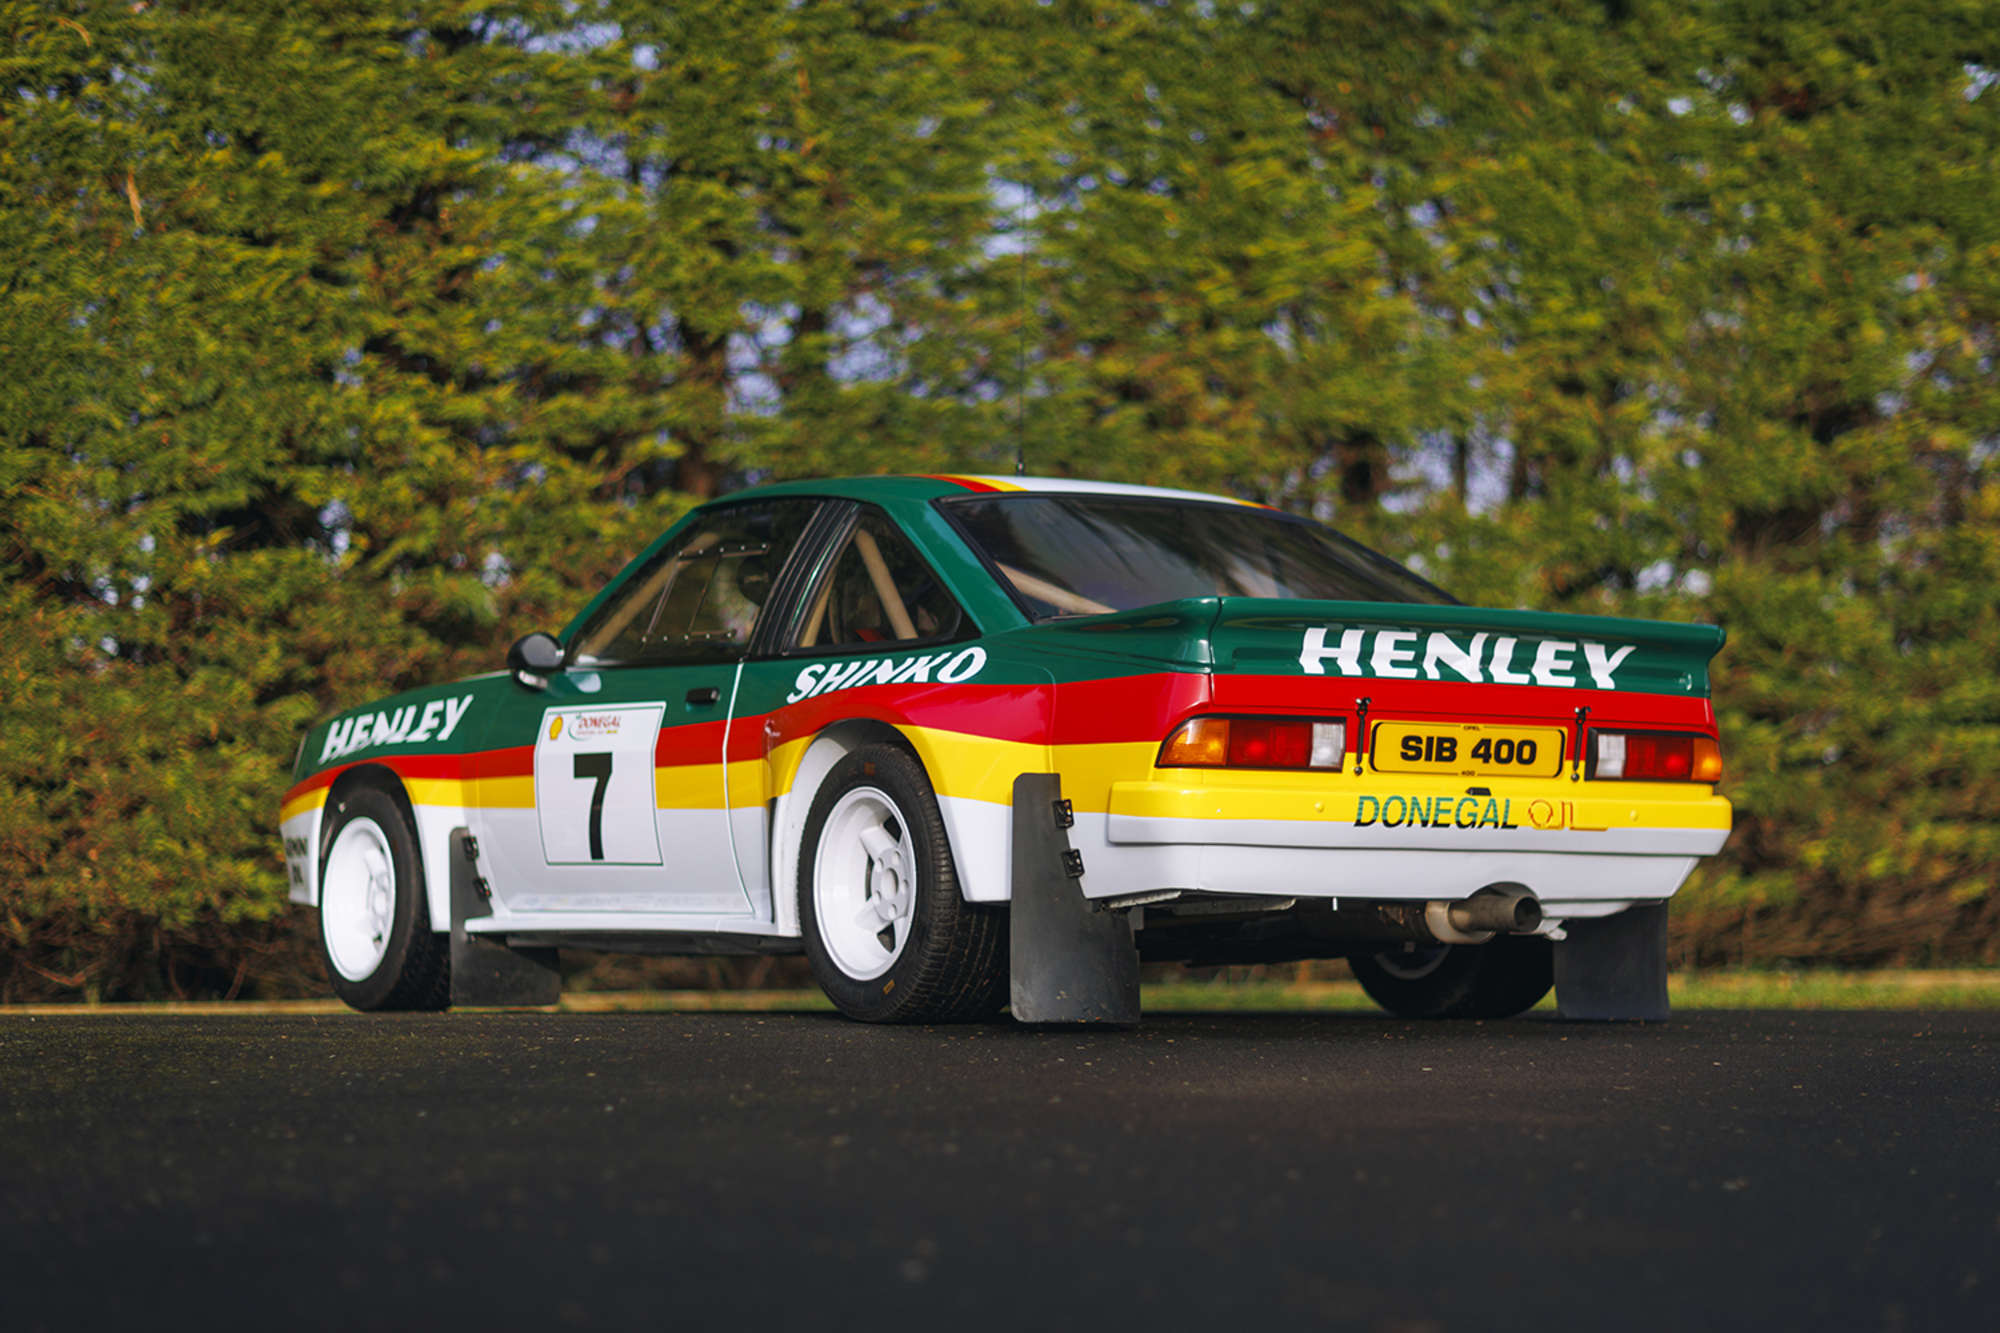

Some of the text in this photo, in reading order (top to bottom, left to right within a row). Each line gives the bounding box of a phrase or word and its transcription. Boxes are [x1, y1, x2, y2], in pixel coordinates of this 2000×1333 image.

[787, 647, 987, 704] SHINKO
[1299, 627, 1637, 690] HENLEY
[318, 694, 474, 765] HENLEY
[1400, 735, 1537, 765] SIB 400
[573, 751, 613, 860] 7
[1353, 795, 1608, 831] DONEGAL OIL
